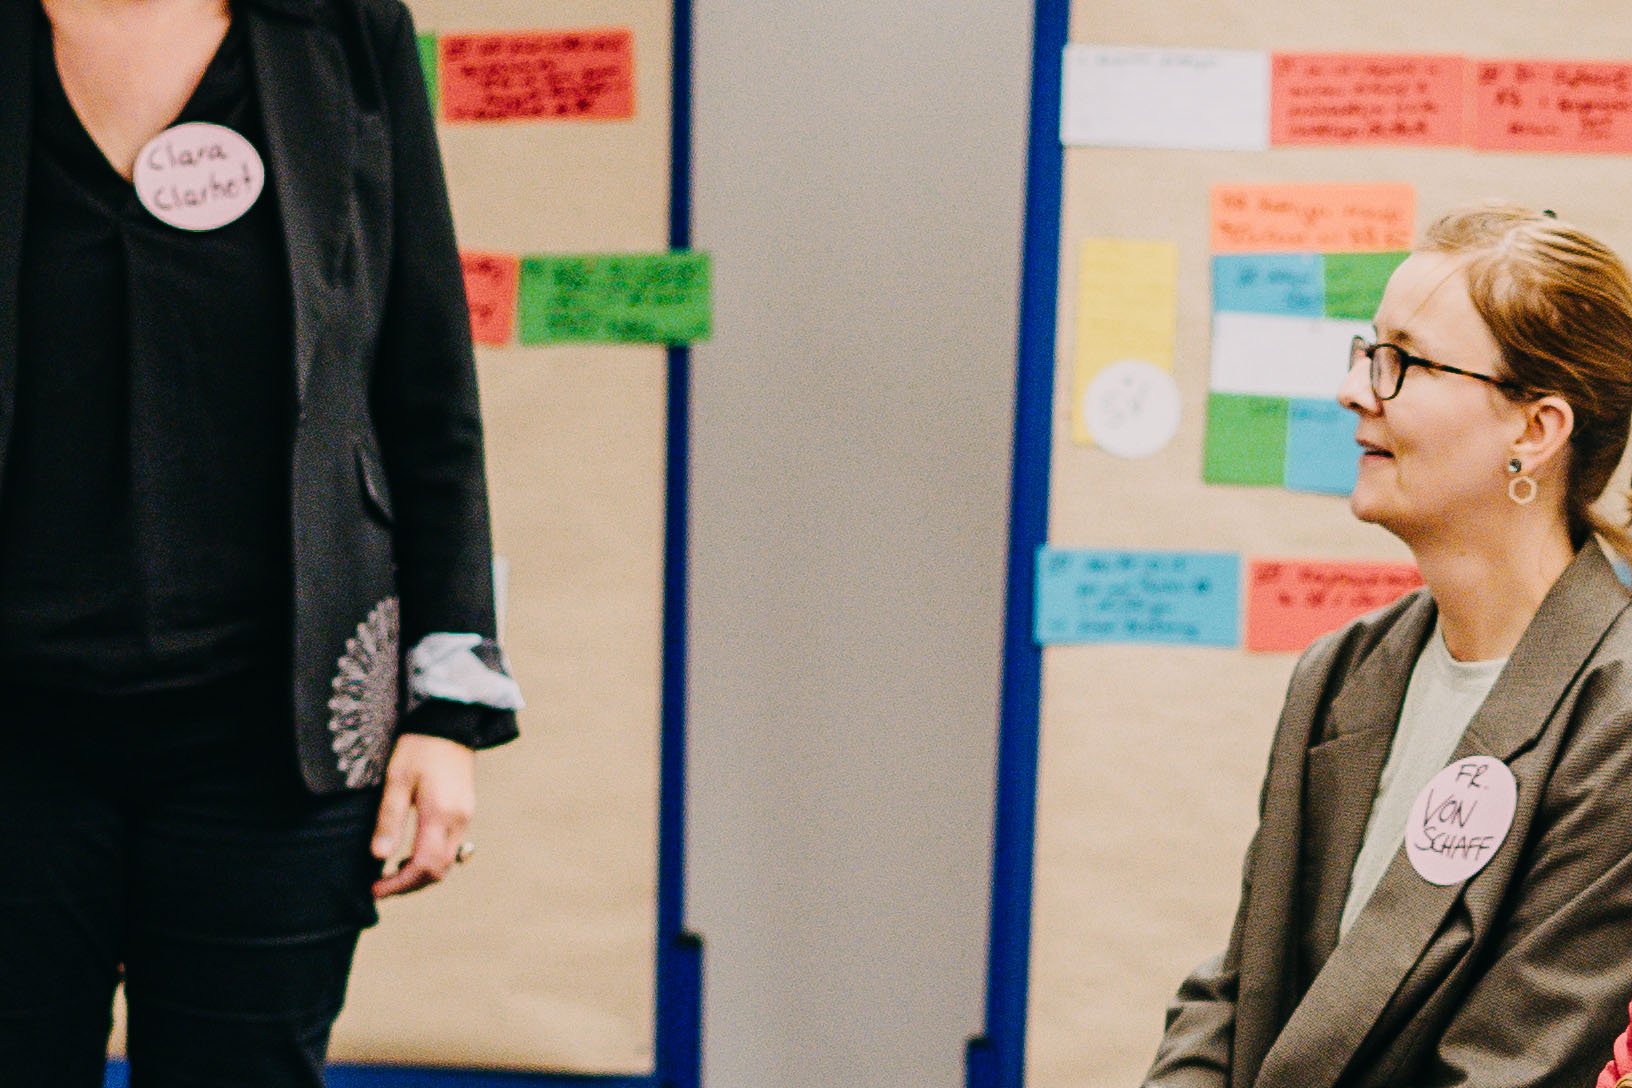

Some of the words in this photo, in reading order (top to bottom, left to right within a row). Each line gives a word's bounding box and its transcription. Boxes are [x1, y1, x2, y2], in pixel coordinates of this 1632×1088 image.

[147, 141, 227, 170] Clara
[1423, 788, 1479, 828] VON
[1414, 826, 1494, 861] SCHAFF
